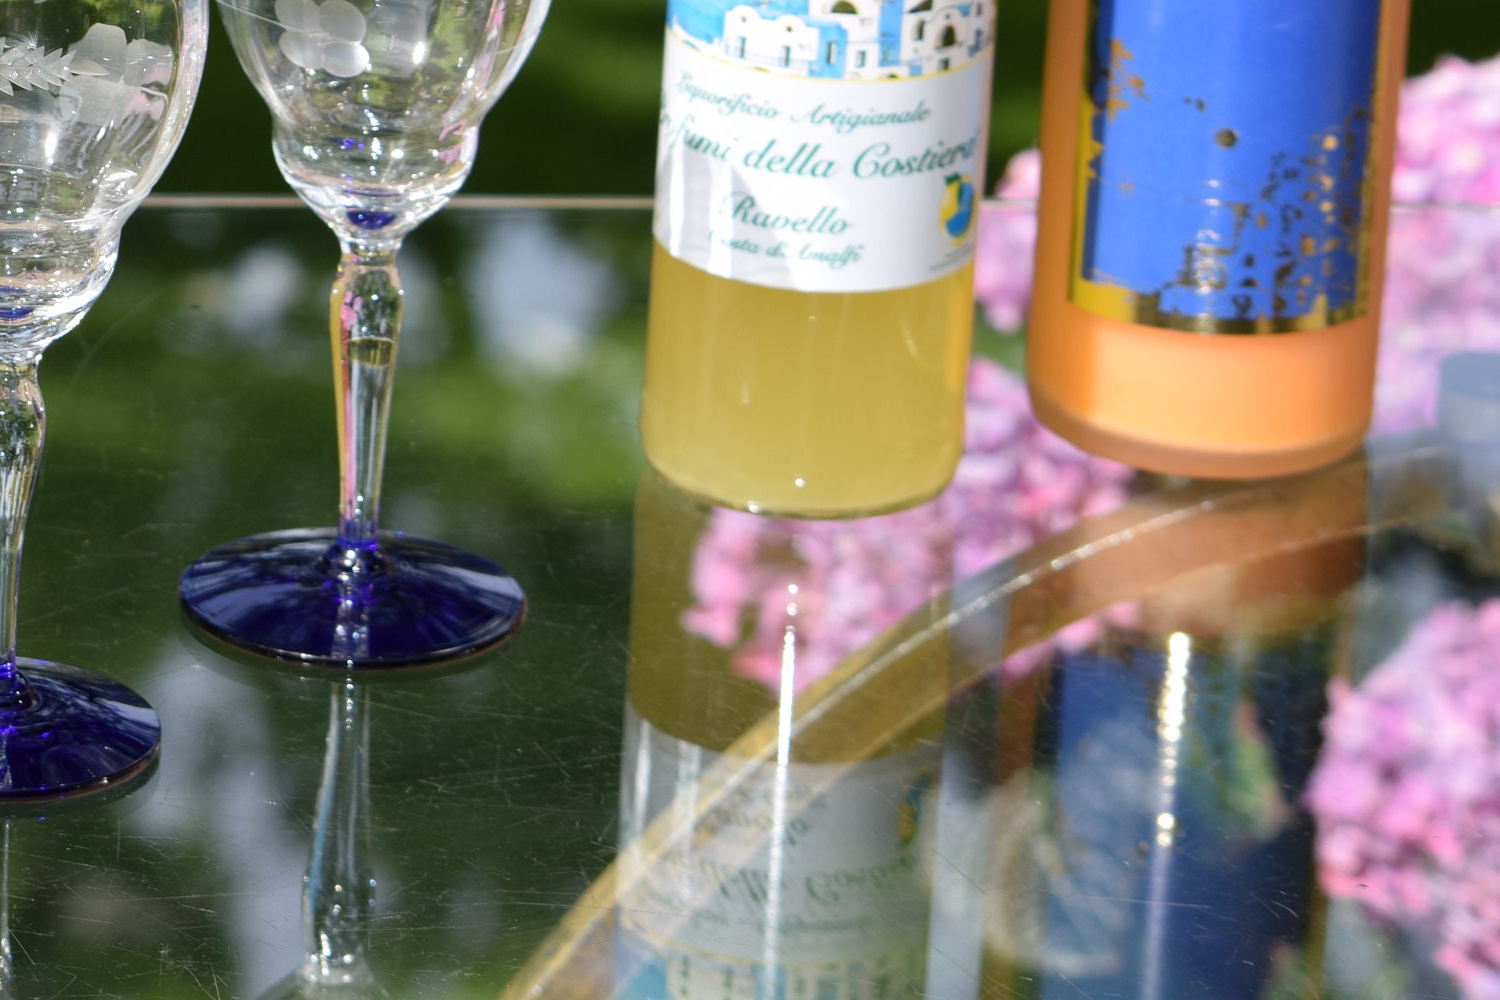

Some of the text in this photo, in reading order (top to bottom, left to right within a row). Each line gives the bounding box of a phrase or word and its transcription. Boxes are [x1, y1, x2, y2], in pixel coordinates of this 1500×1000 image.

[790, 99, 931, 134] Artigianale
[743, 138, 836, 178] della
[719, 191, 851, 235] Ravello
